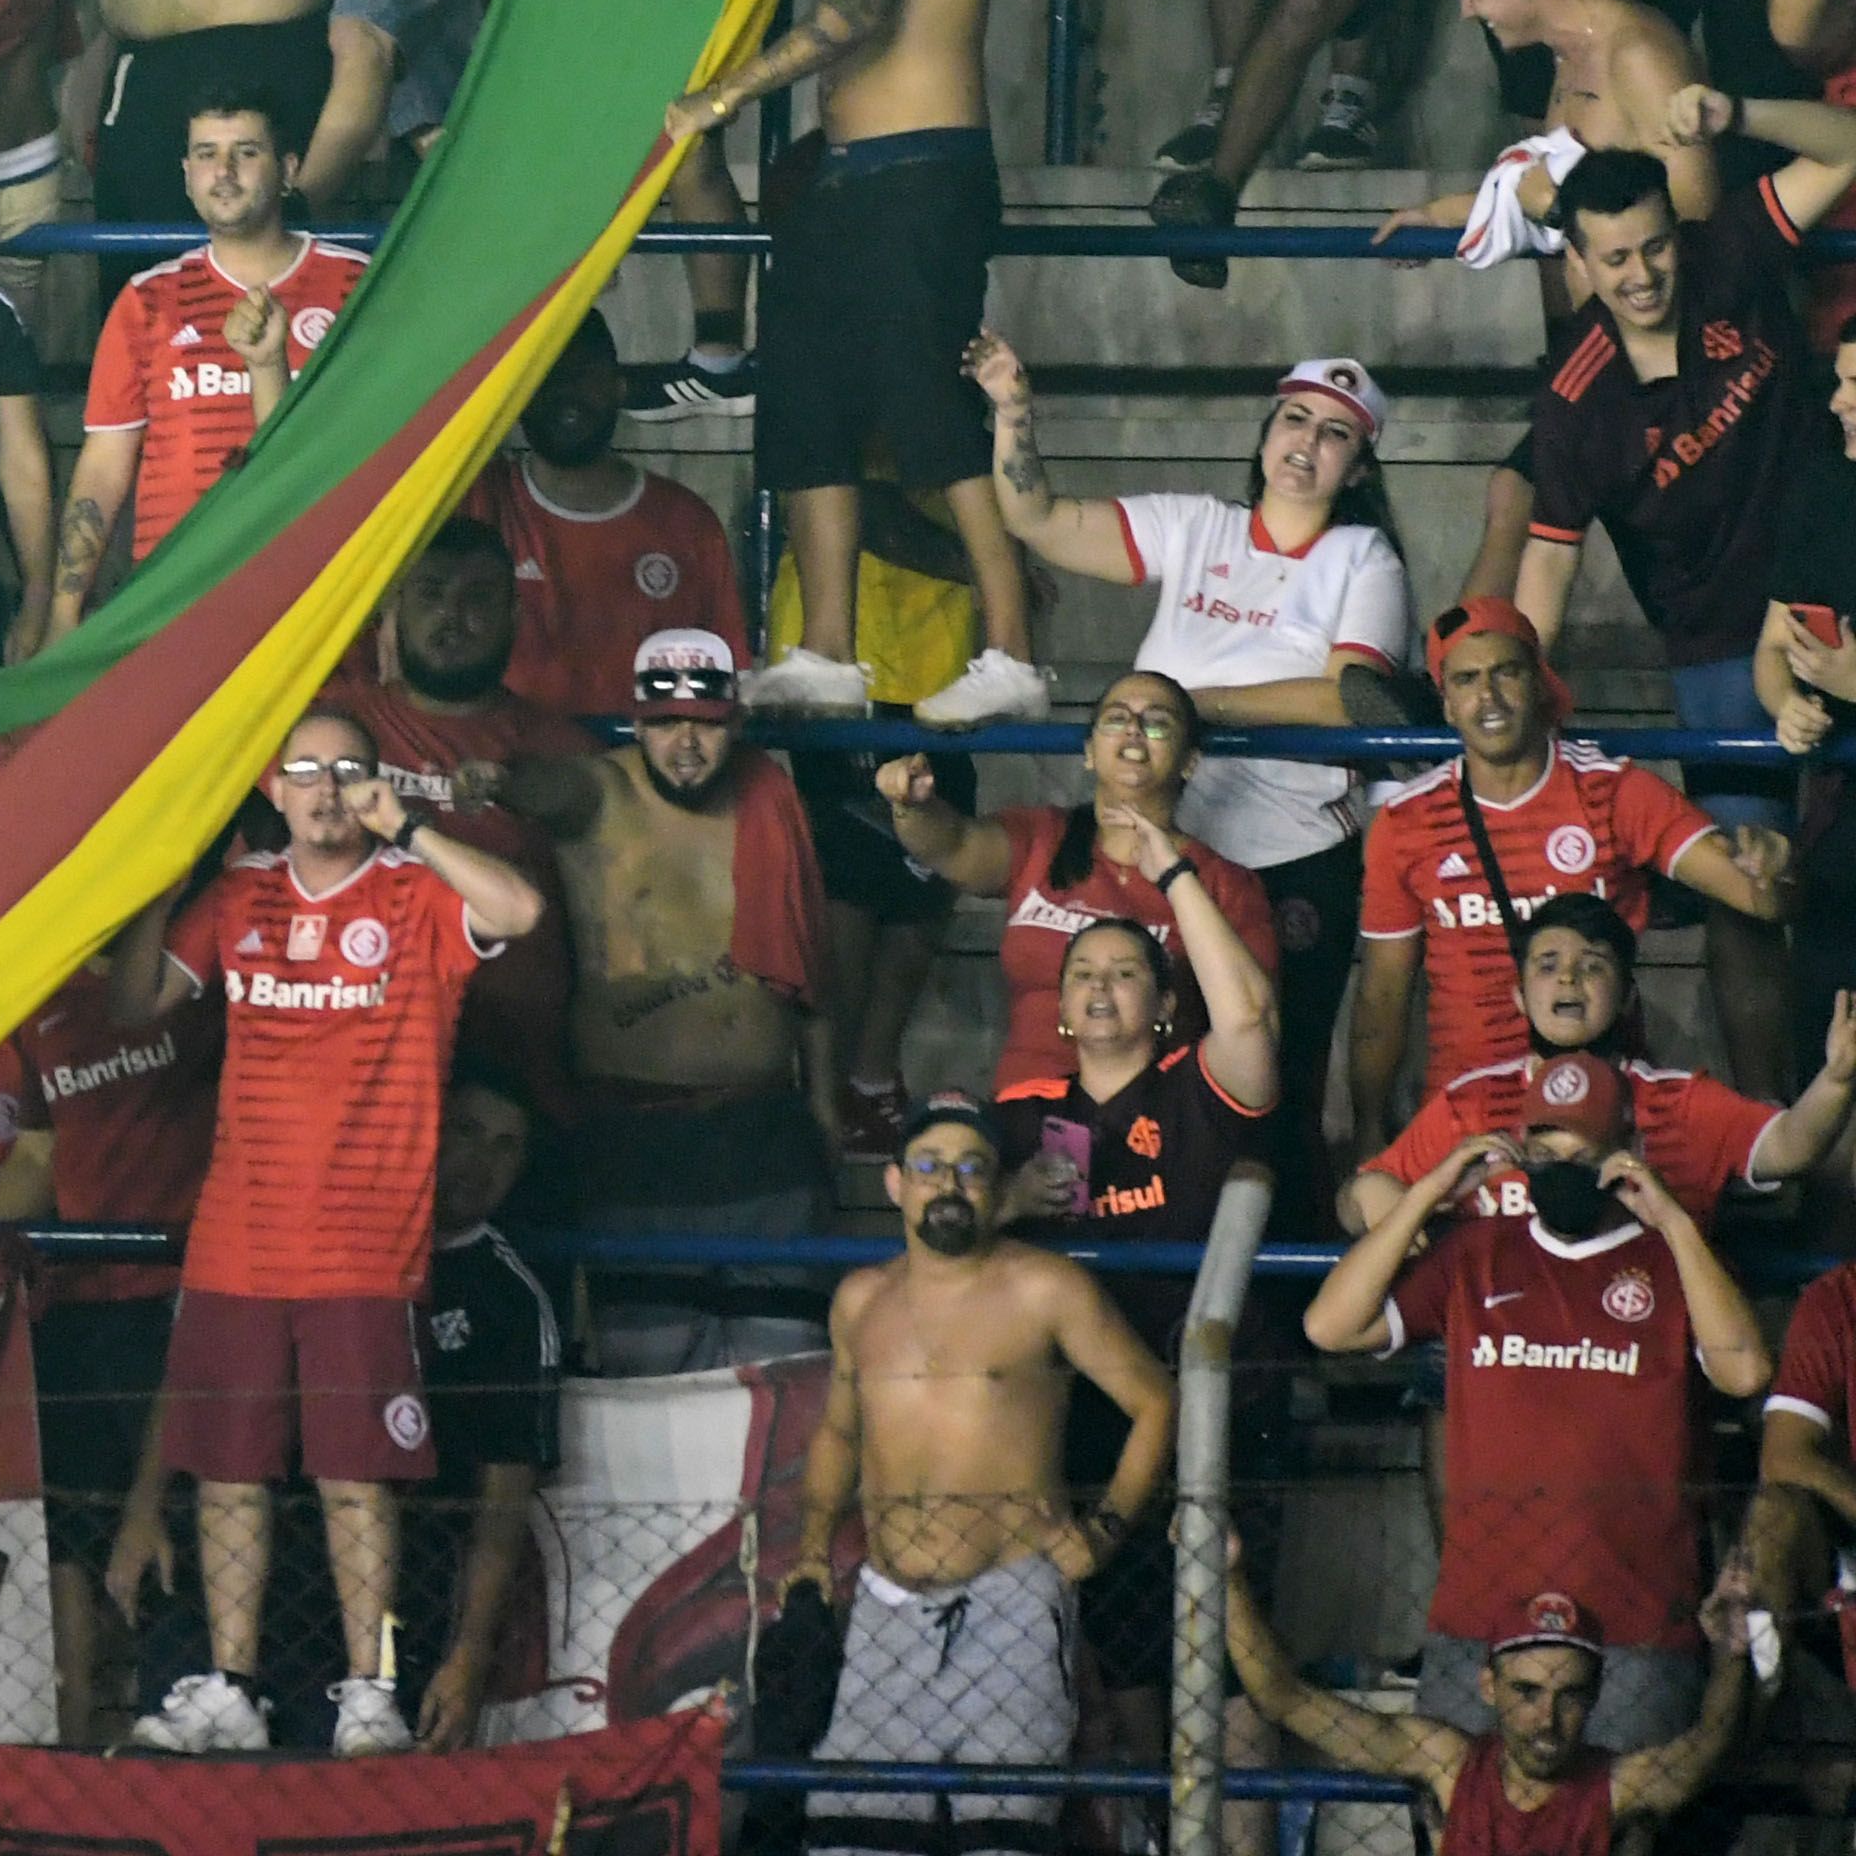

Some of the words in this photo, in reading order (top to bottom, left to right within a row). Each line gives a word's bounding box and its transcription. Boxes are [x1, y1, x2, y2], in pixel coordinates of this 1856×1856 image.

[249, 972, 391, 1011] Banrisul
[54, 1032, 179, 1099] Banrisul
[1501, 1333, 1641, 1377] Banrisul
